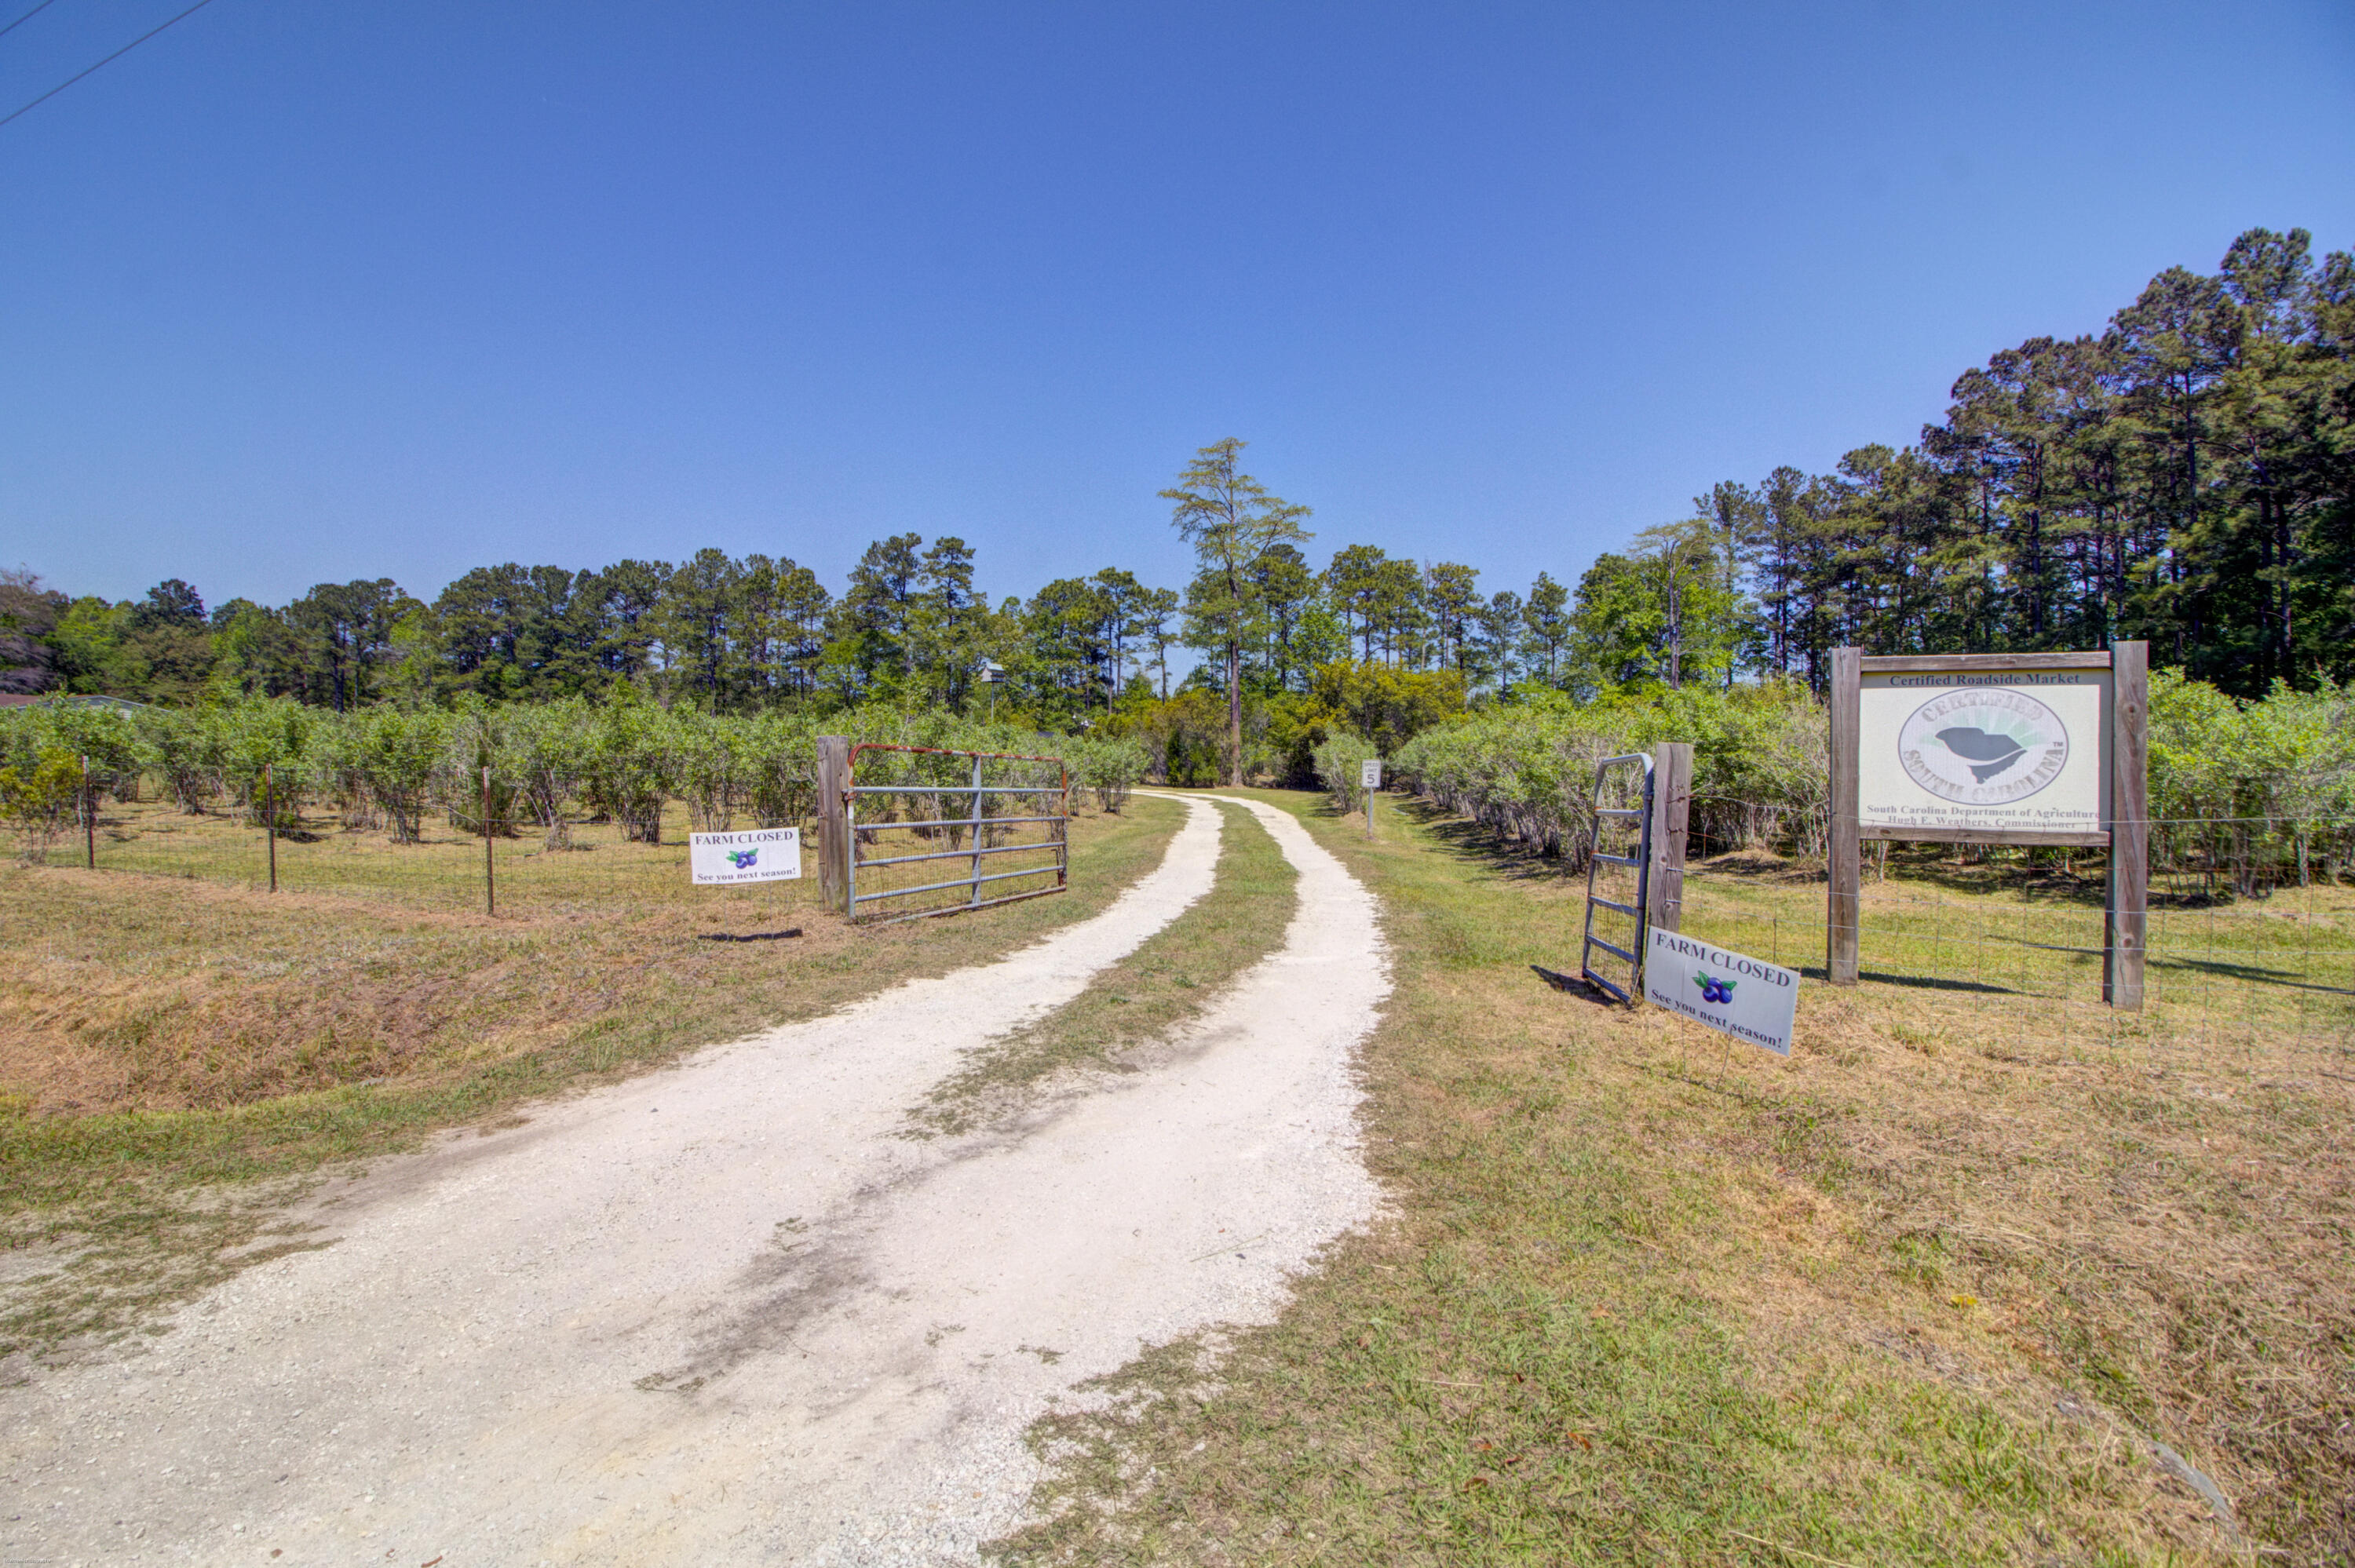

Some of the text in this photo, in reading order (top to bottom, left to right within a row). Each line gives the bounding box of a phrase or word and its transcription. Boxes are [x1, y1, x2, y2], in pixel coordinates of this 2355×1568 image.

[1889, 673, 2079, 686] Certified Roadside Market
[1921, 691, 2044, 722] CERTIFIED
[1367, 774, 1375, 784] 5
[1903, 748, 2065, 802] SOUTH CAROLINA
[1867, 804, 2100, 820] South Carolina Department of Agriculture
[1887, 815, 1916, 826] Hugh
[1995, 818, 2076, 829] Commissioner
[696, 831, 793, 845] FARM CLOSED
[761, 867, 796, 878] season!
[1656, 933, 1791, 987] FARM CLOSED
[1651, 989, 1783, 1048] See you next season!
